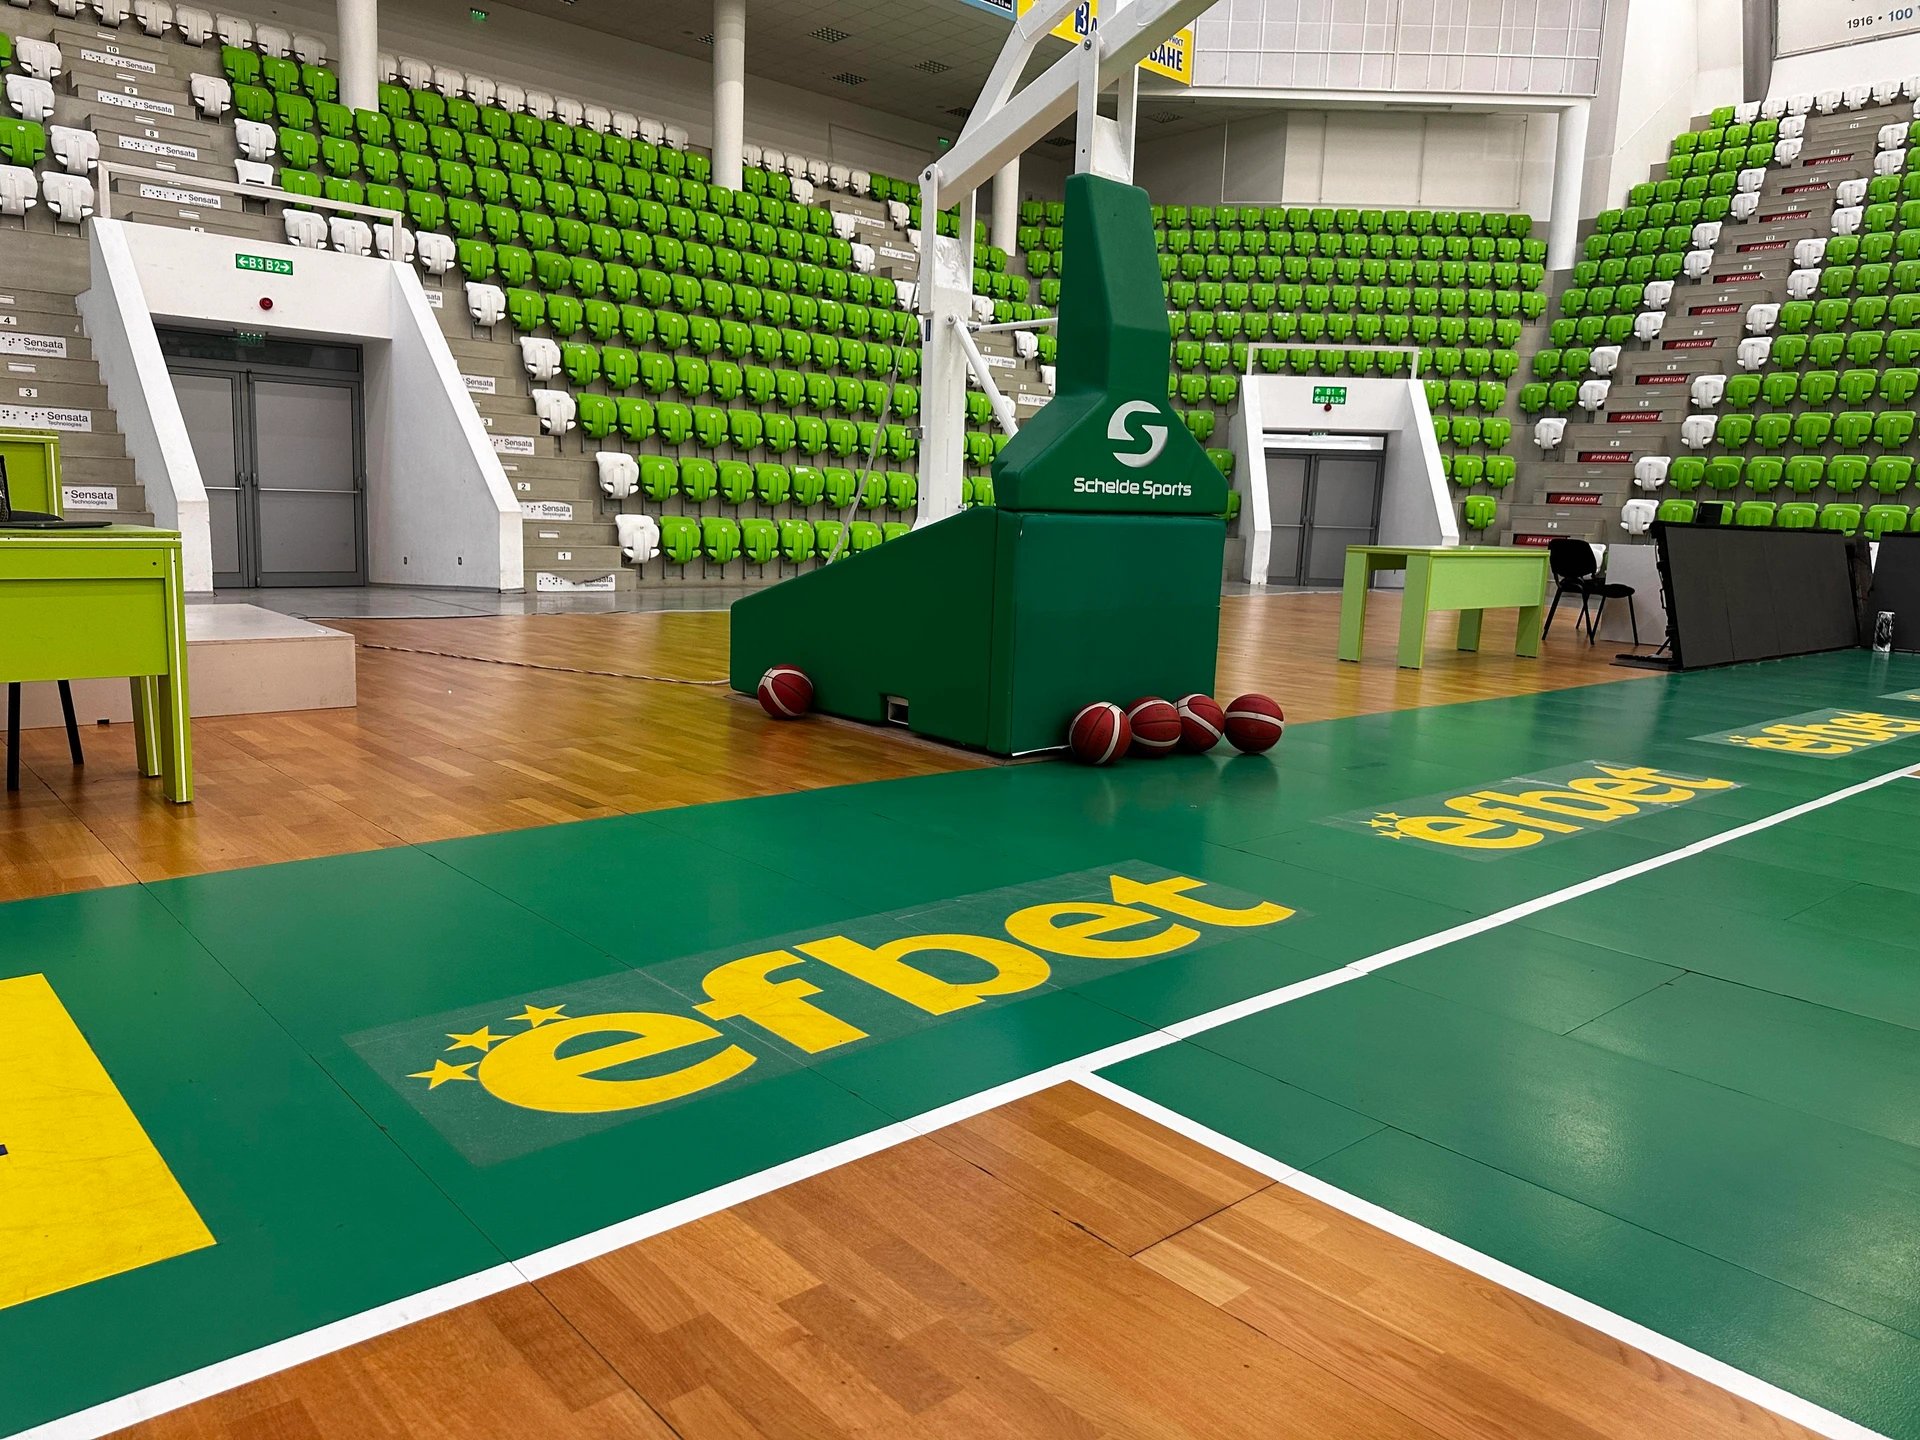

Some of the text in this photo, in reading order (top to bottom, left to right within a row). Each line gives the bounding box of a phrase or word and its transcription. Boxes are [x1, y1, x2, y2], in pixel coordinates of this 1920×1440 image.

[1847, 8, 1913, 29] 1916 100
[125, 60, 154, 72] Sensata
[143, 102, 173, 114] Sensata
[166, 146, 196, 158] Sensata
[188, 194, 219, 205] Sensata
[23, 337, 64, 349] Sensata
[466, 378, 494, 387] Sensata
[25, 388, 32, 397] 3
[47, 411, 89, 422] Sensata
[504, 438, 533, 447] Sensata
[1074, 477, 1192, 499] Schelde Sports
[70, 489, 114, 500] Sensata
[542, 504, 570, 513] Sensata
[1746, 711, 1920, 754] efbet
[1395, 766, 1734, 849] efbet
[477, 875, 1296, 1113] efbet
